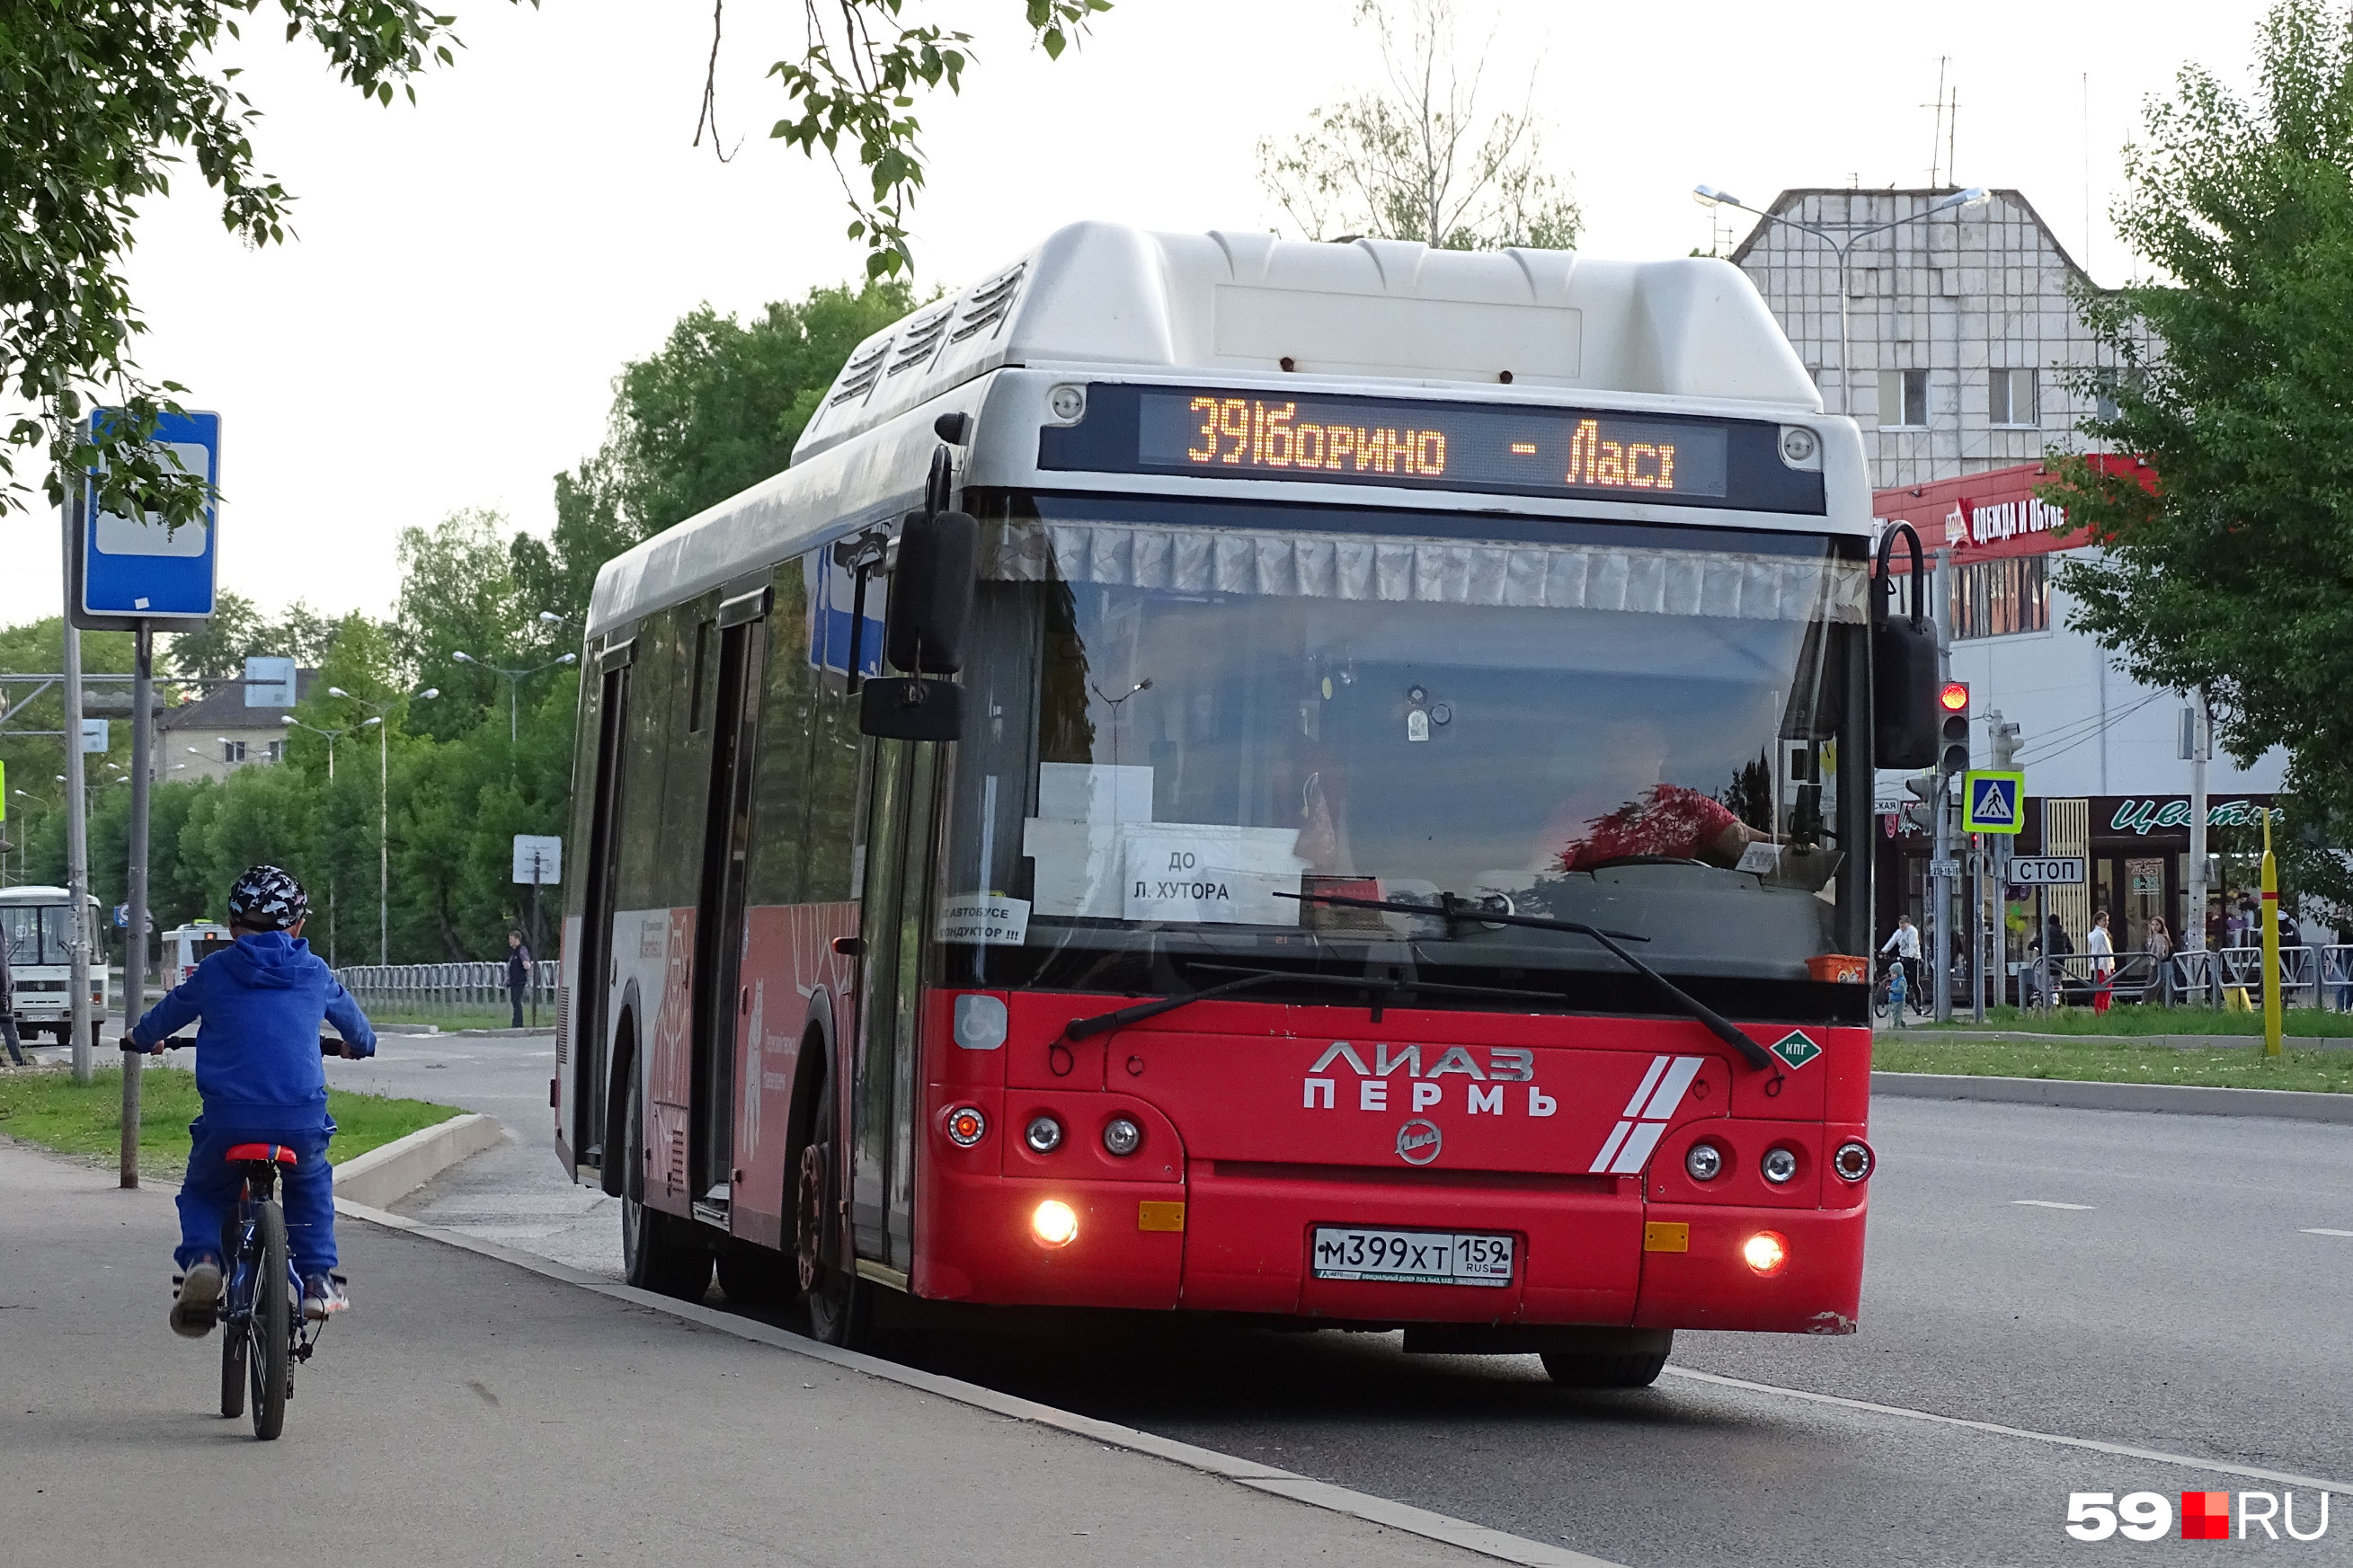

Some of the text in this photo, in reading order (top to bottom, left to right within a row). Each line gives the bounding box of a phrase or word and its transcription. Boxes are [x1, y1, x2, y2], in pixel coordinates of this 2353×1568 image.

[1973, 501, 2017, 545] ОДЕЖДА
[2019, 500, 2028, 534] И
[1168, 852, 1195, 873] ДО
[2020, 862, 2074, 880] СТОП
[1134, 881, 1230, 900] Л. ХУТОРА
[950, 907, 1010, 919] АВТОБУСЕ
[1785, 1042, 1807, 1056] КПГ
[1309, 1041, 1534, 1082] ЛИАЗ
[1303, 1078, 1558, 1117] ПЕРМЬ
[1324, 1235, 1505, 1271] М399ХТ 159
[1466, 1263, 1489, 1273] RUS
